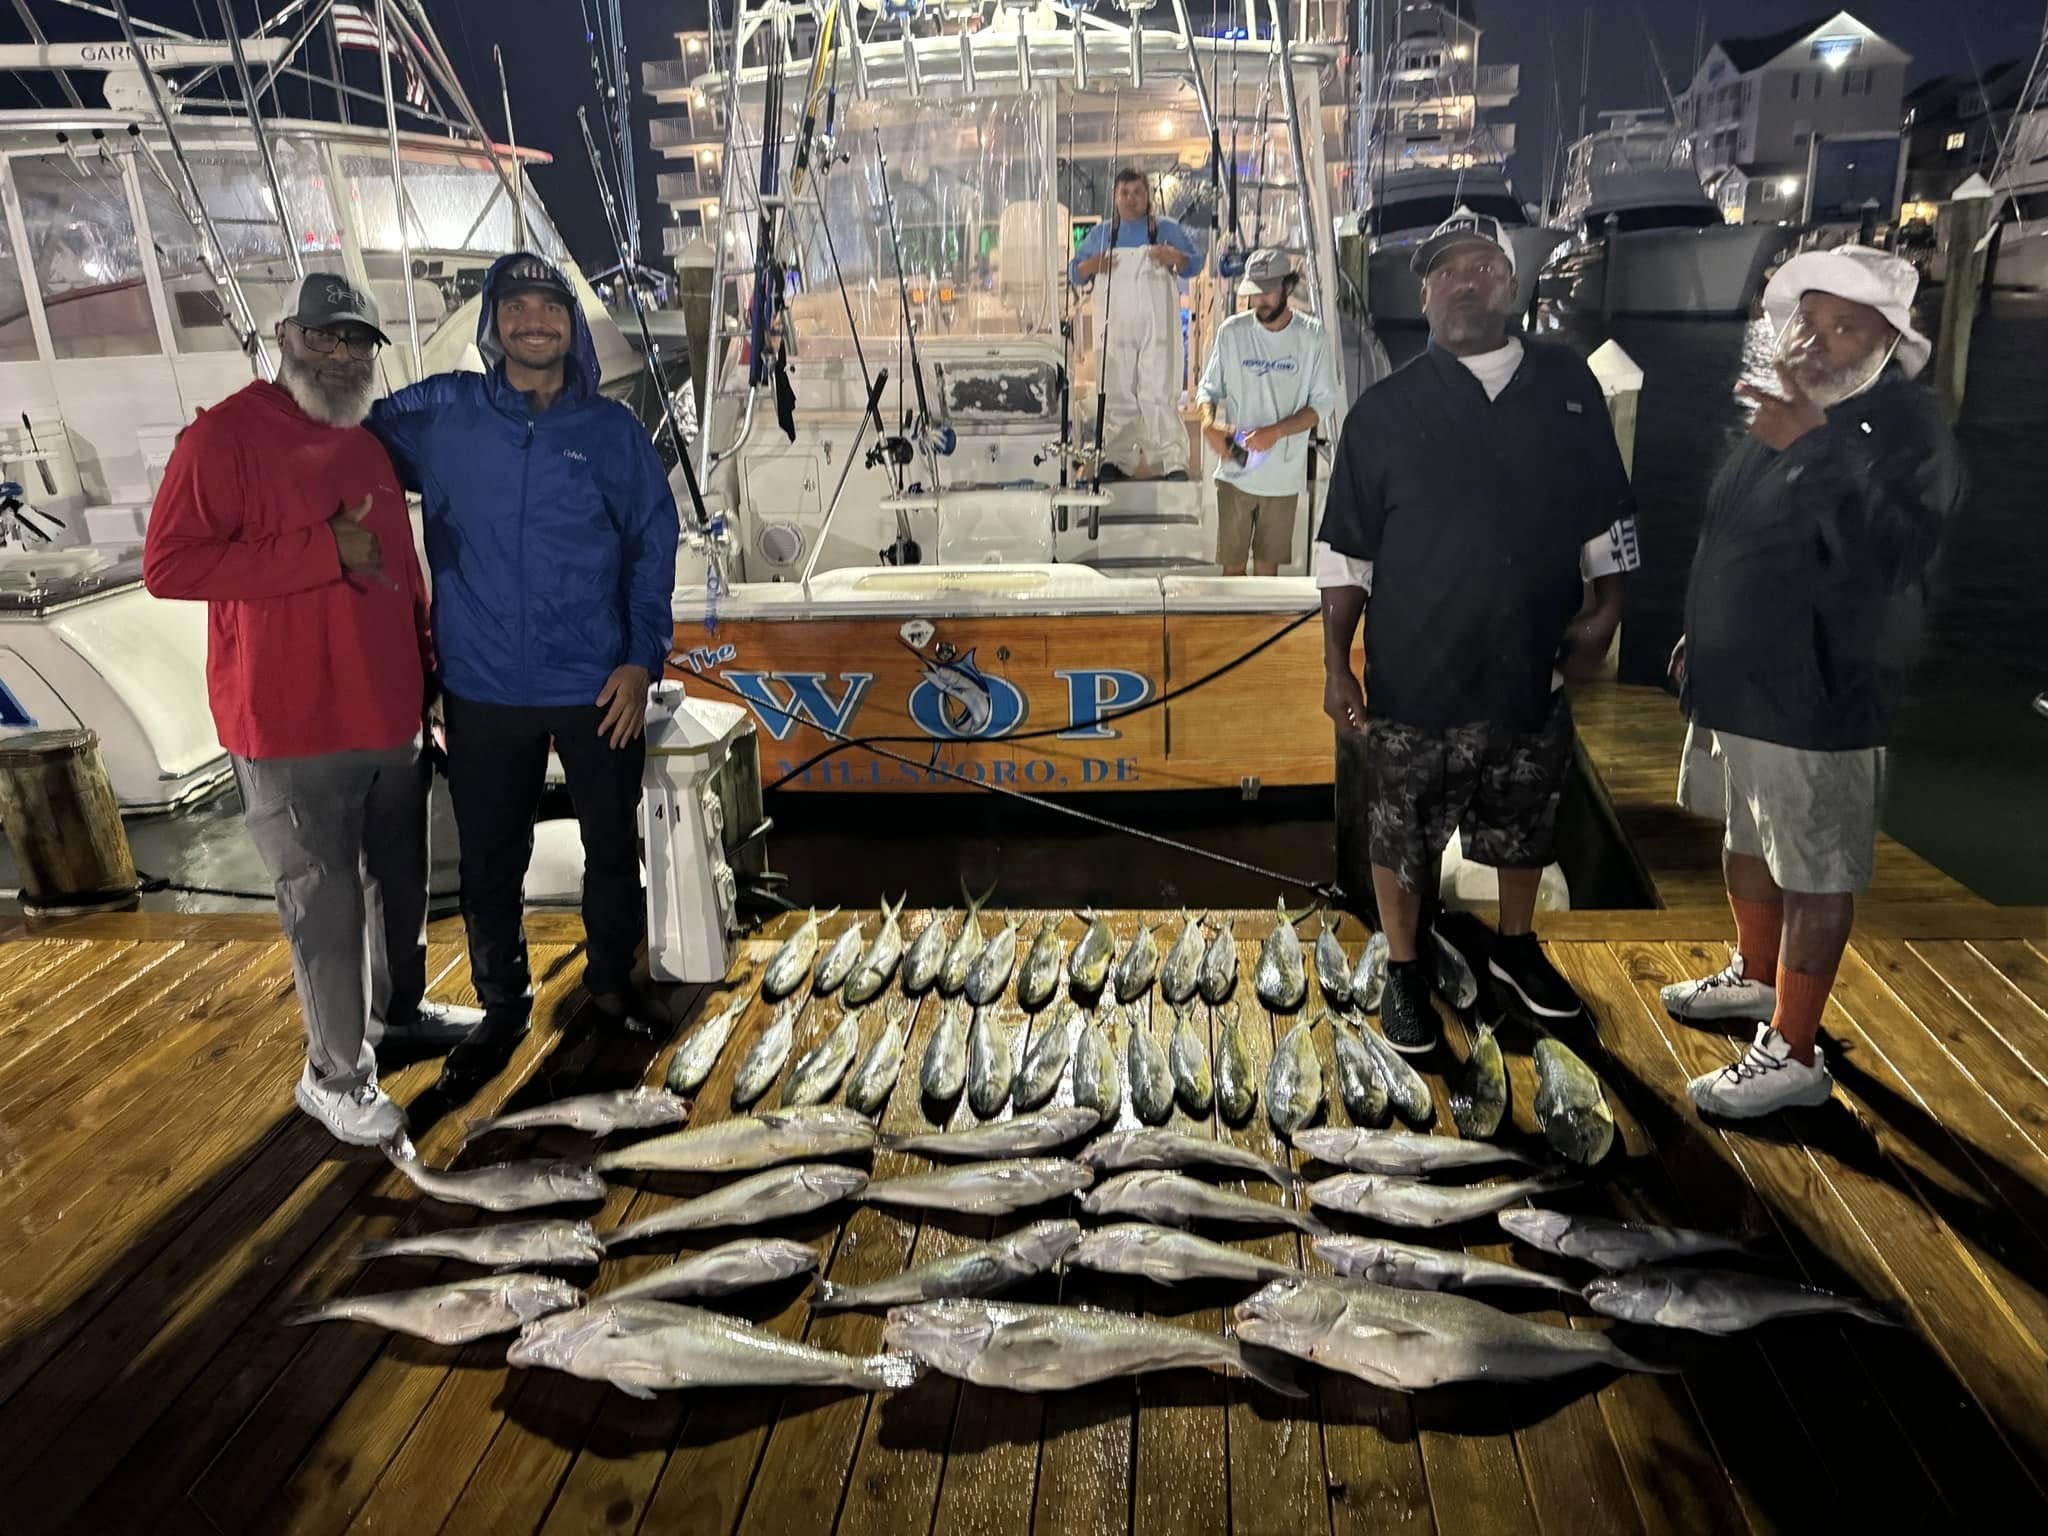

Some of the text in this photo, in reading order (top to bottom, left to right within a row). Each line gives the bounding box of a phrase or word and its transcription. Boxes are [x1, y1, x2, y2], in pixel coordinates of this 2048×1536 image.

[671, 643, 737, 674] The
[719, 668, 1152, 741] WOP
[1082, 757, 1140, 784] DE
